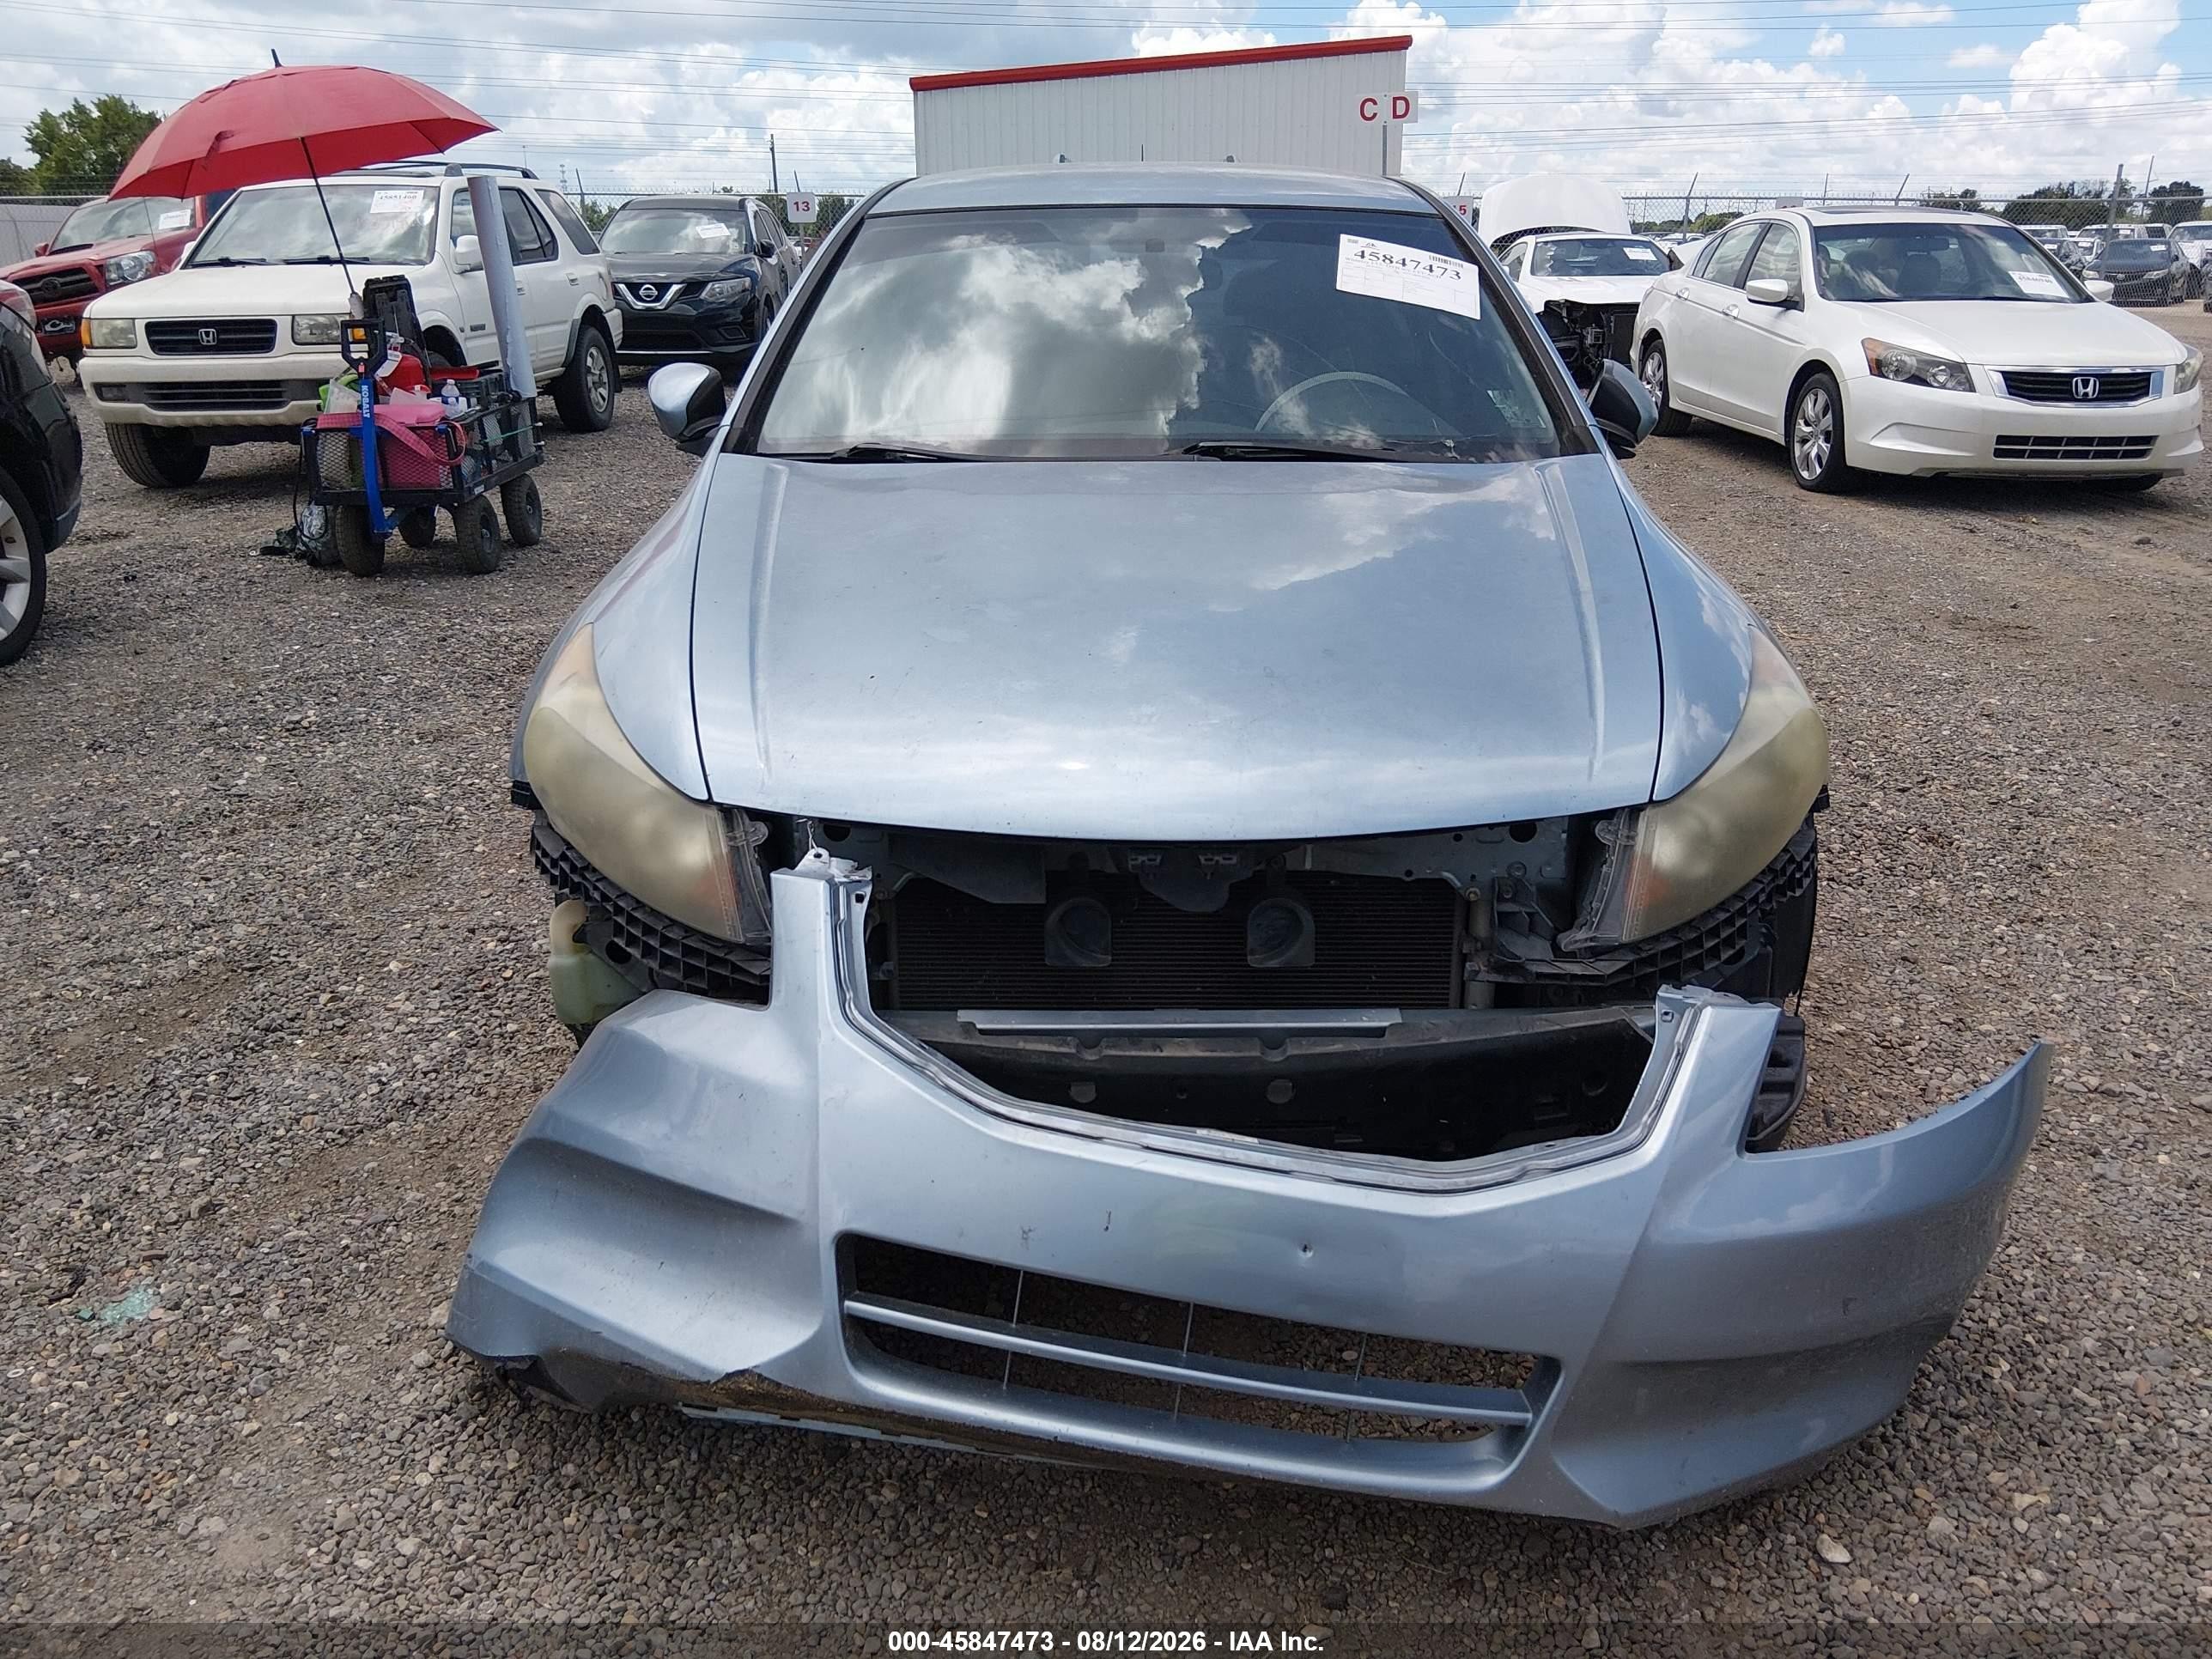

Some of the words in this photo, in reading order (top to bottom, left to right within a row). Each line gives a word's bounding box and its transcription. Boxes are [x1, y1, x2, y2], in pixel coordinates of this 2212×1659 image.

[1360, 98, 1377, 121] C
[1392, 96, 1410, 119] D
[793, 200, 811, 212] 13
[1353, 249, 1462, 281] 45847473
[362, 385, 371, 418] KOBALT
